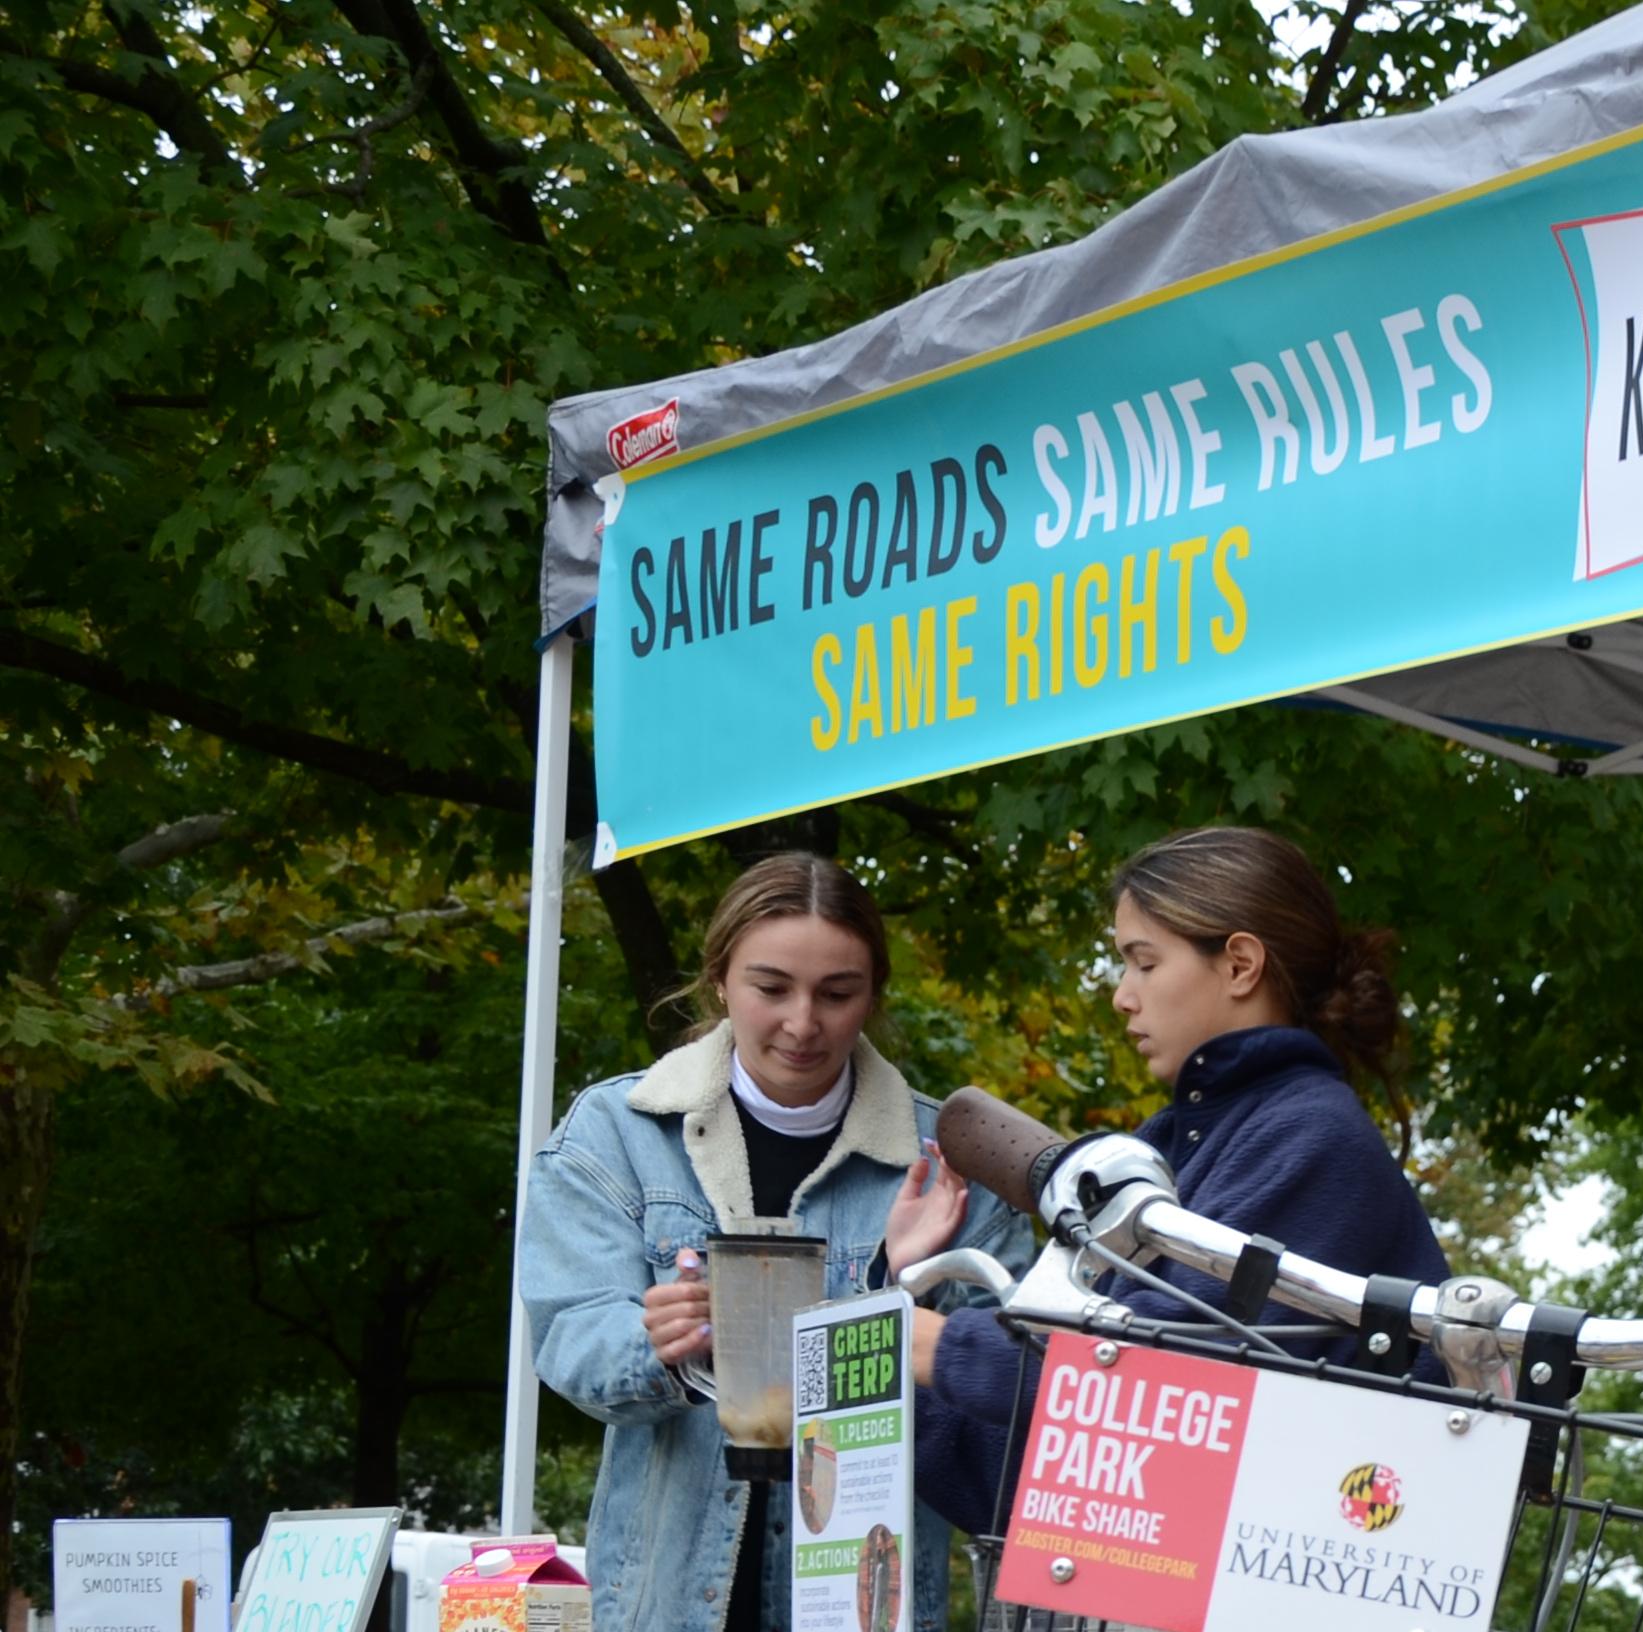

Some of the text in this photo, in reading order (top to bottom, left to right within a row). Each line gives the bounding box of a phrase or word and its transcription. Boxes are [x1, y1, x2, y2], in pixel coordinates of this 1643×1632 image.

[611, 421, 662, 467] Coleman
[630, 293, 1493, 658] SAME ROADS SAME RULES
[810, 525, 1250, 752] SAME RIGHTS
[834, 1316, 895, 1358] GREEN
[833, 1353, 895, 1401] TERP
[839, 1416, 895, 1444] 1.PLEDGE
[1045, 1364, 1241, 1453] COLLEGE
[1031, 1424, 1156, 1500] PARK
[1021, 1487, 1166, 1546] BIKE SHARE
[66, 1551, 179, 1568] PUMPKIN SPICE
[267, 1531, 373, 1582] TRY OUR
[798, 1546, 859, 1571] 2.ACTIONS
[1014, 1528, 1199, 1580] ZAGSTER.COM/COLLEGEPARK
[1236, 1522, 1486, 1585] UNIVERSITY OF
[82, 1577, 163, 1594] SMOOTHIES
[1226, 1542, 1481, 1619] MARYLAND
